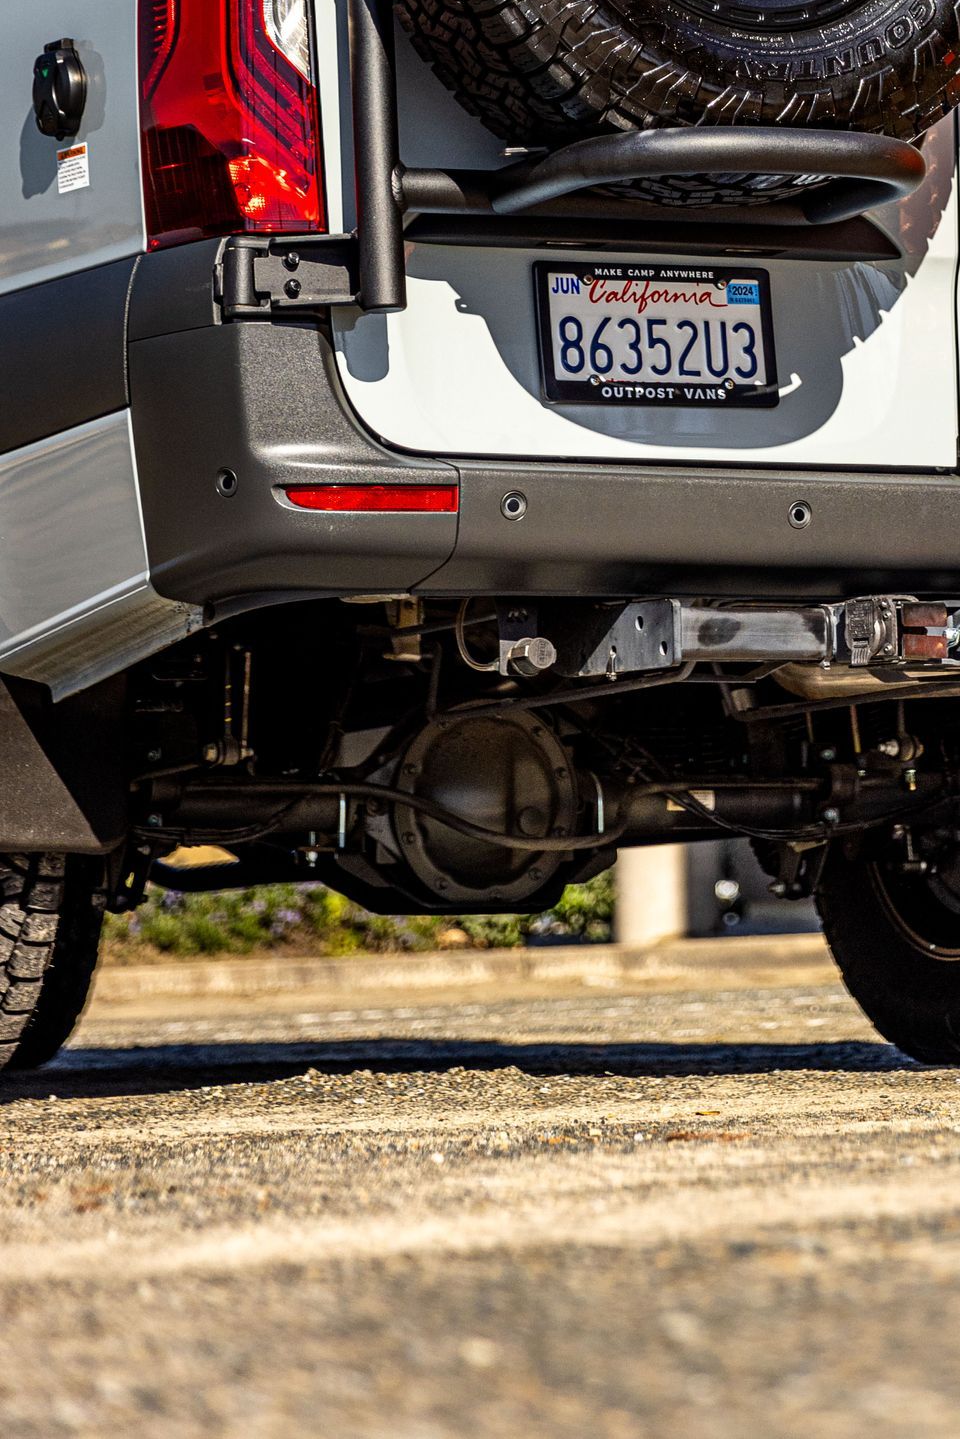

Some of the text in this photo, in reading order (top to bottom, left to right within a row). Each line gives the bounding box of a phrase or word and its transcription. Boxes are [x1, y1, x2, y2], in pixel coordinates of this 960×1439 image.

[594, 268, 714, 279] MAKE CAMP ANYWHERE
[552, 277, 580, 294] JUN
[589, 280, 728, 313] California
[732, 286, 753, 296] 2024
[559, 316, 758, 378] 86352U3
[601, 386, 727, 400] OUTPOST VANS
